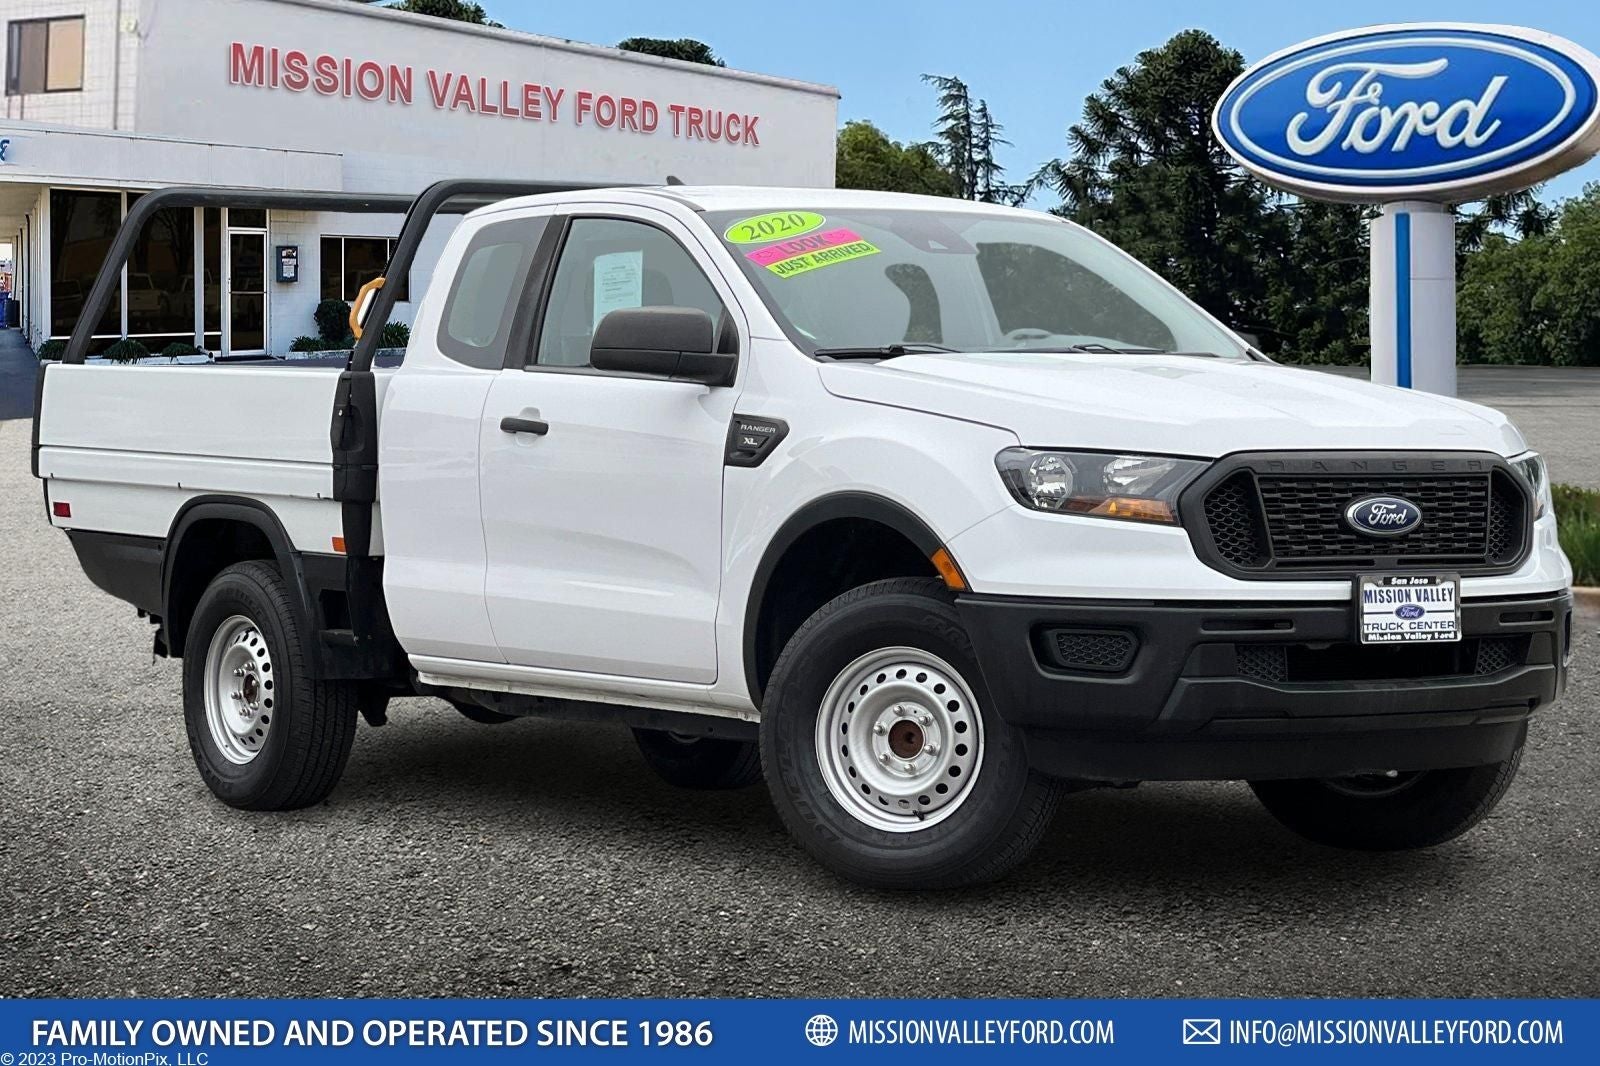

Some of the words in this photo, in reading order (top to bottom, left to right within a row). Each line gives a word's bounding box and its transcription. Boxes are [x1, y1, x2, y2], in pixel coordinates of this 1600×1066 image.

[229, 41, 413, 104] MISSION
[427, 70, 566, 123] VALLEY
[575, 91, 659, 134] FORD
[667, 104, 761, 146] TRUCK
[1285, 57, 1509, 156] Ford
[741, 213, 806, 241] 2020
[775, 234, 829, 254] LOOK
[774, 256, 808, 275] JUST
[813, 242, 874, 263] ARRIVED
[740, 424, 776, 433] RANGER
[743, 437, 758, 445] XL
[1266, 460, 1483, 472] RANGER
[1367, 502, 1408, 526] Ford
[1364, 588, 1412, 604] MISSION
[1415, 587, 1454, 602] VALLEY
[1400, 606, 1420, 618] Ford
[1364, 622, 1404, 631] TRUCK
[1409, 620, 1455, 630] CENTER
[1404, 632, 1432, 641] Valley
